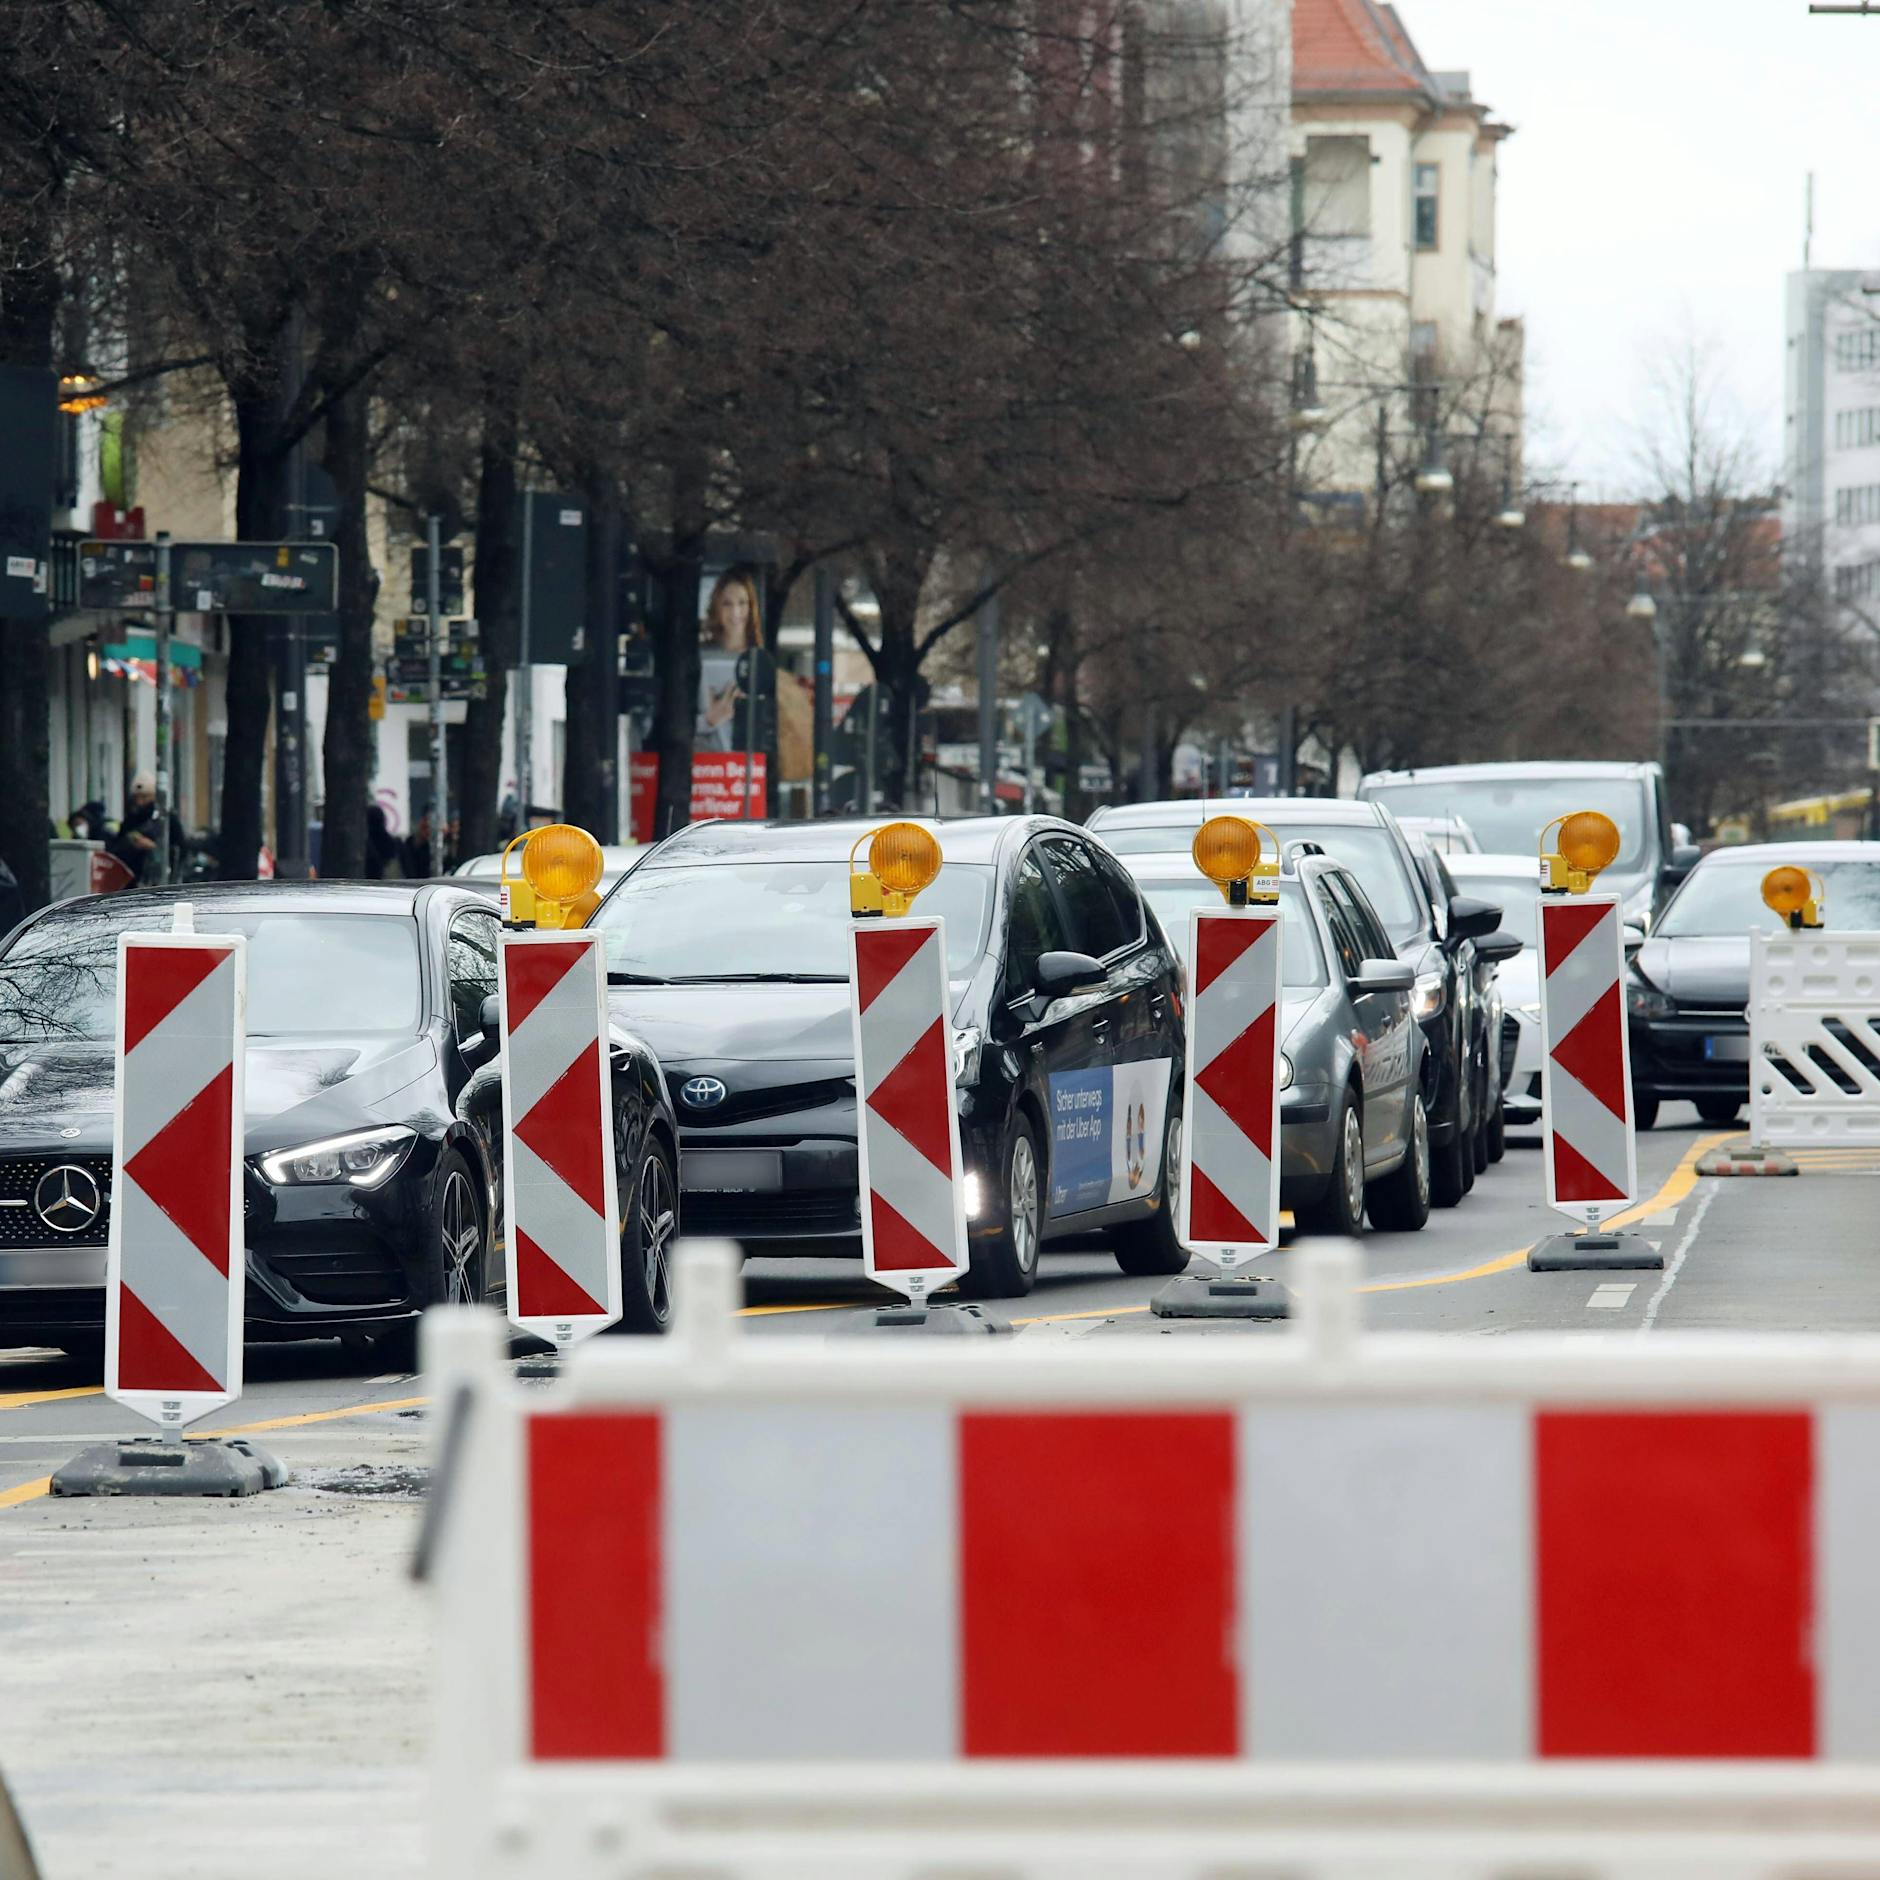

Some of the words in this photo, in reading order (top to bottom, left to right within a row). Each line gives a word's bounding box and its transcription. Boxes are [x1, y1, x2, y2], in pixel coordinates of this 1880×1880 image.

[1057, 1089, 1074, 1112] Sicher
[1074, 1088, 1102, 1112] unterwegs
[1057, 1120, 1066, 1141] mit
[1066, 1118, 1076, 1140] der
[1076, 1116, 1089, 1139] Uber
[1090, 1114, 1102, 1142] App
